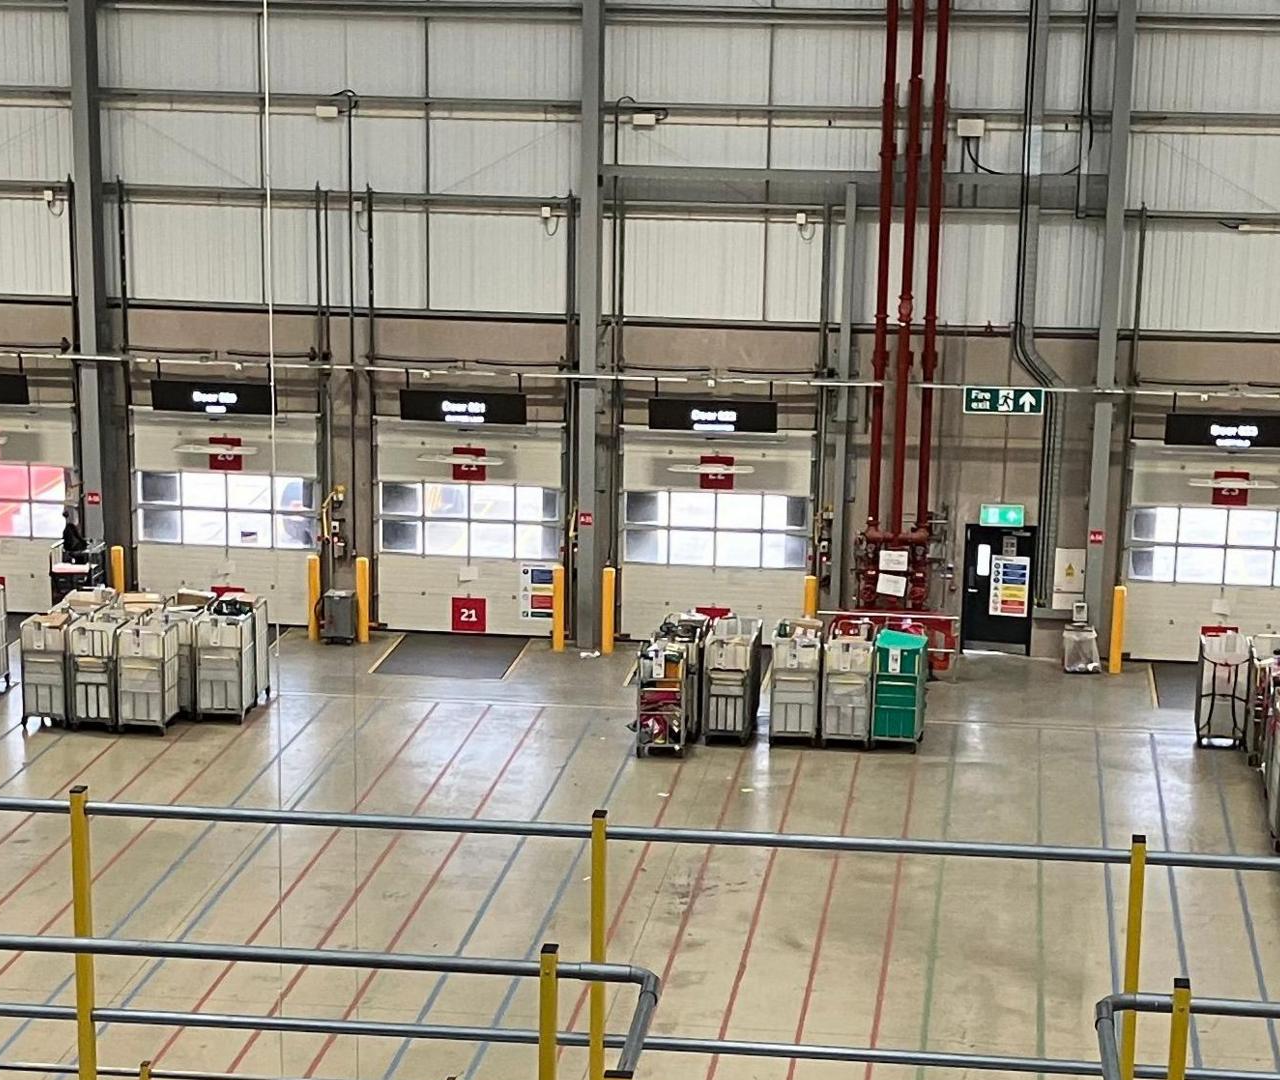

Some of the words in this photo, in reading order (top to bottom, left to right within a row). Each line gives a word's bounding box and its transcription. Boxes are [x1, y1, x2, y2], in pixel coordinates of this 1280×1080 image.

[970, 390, 991, 400] Fire
[971, 400, 990, 410] exit
[460, 608, 478, 622] 21
